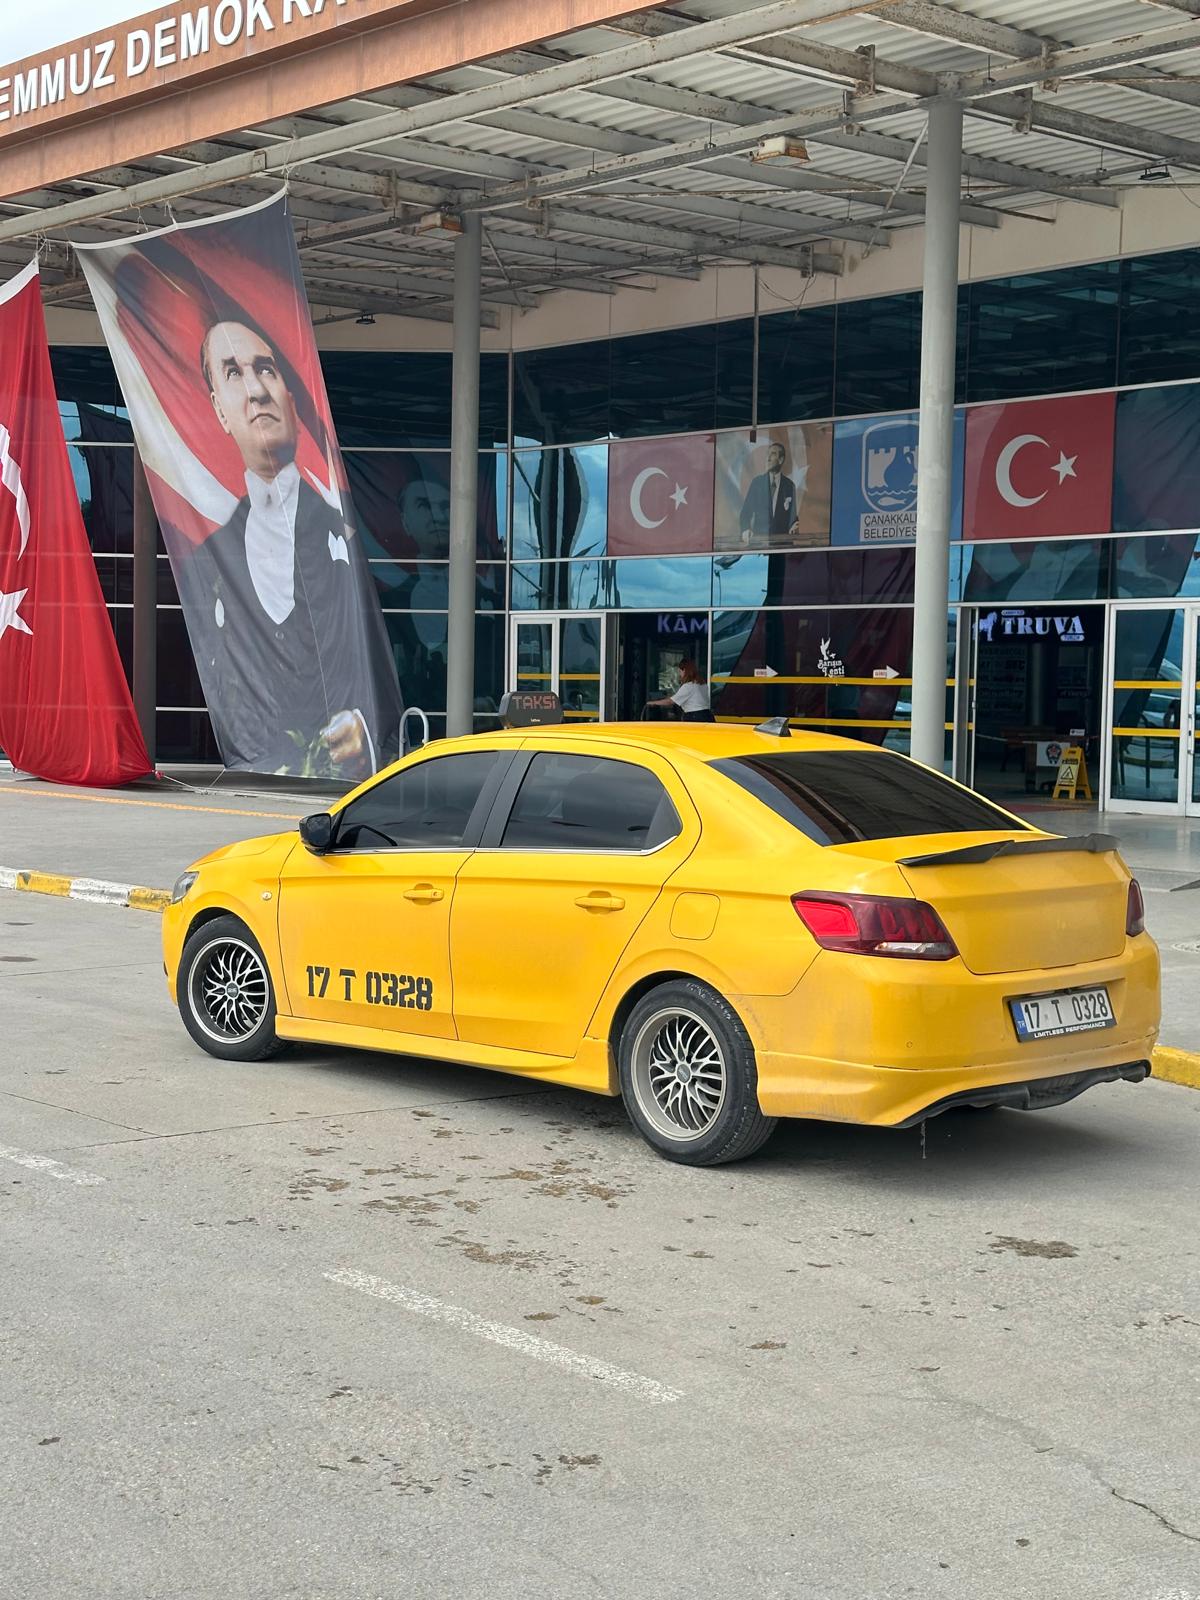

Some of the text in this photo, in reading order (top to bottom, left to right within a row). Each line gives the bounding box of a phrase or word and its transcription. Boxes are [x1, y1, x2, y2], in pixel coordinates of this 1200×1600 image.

[127, 0, 346, 78] DEMOK
[864, 513, 918, 526] ÇANAKKAL
[864, 526, 917, 539] BELEDİYES
[657, 614, 708, 634] KÂM
[1001, 616, 1084, 635] TRUVA
[306, 965, 433, 1011] 17 T 0328
[1024, 993, 1109, 1029] 17 T 0328
[1034, 1021, 1106, 1038] LIMITLESS PERFORMANCE
